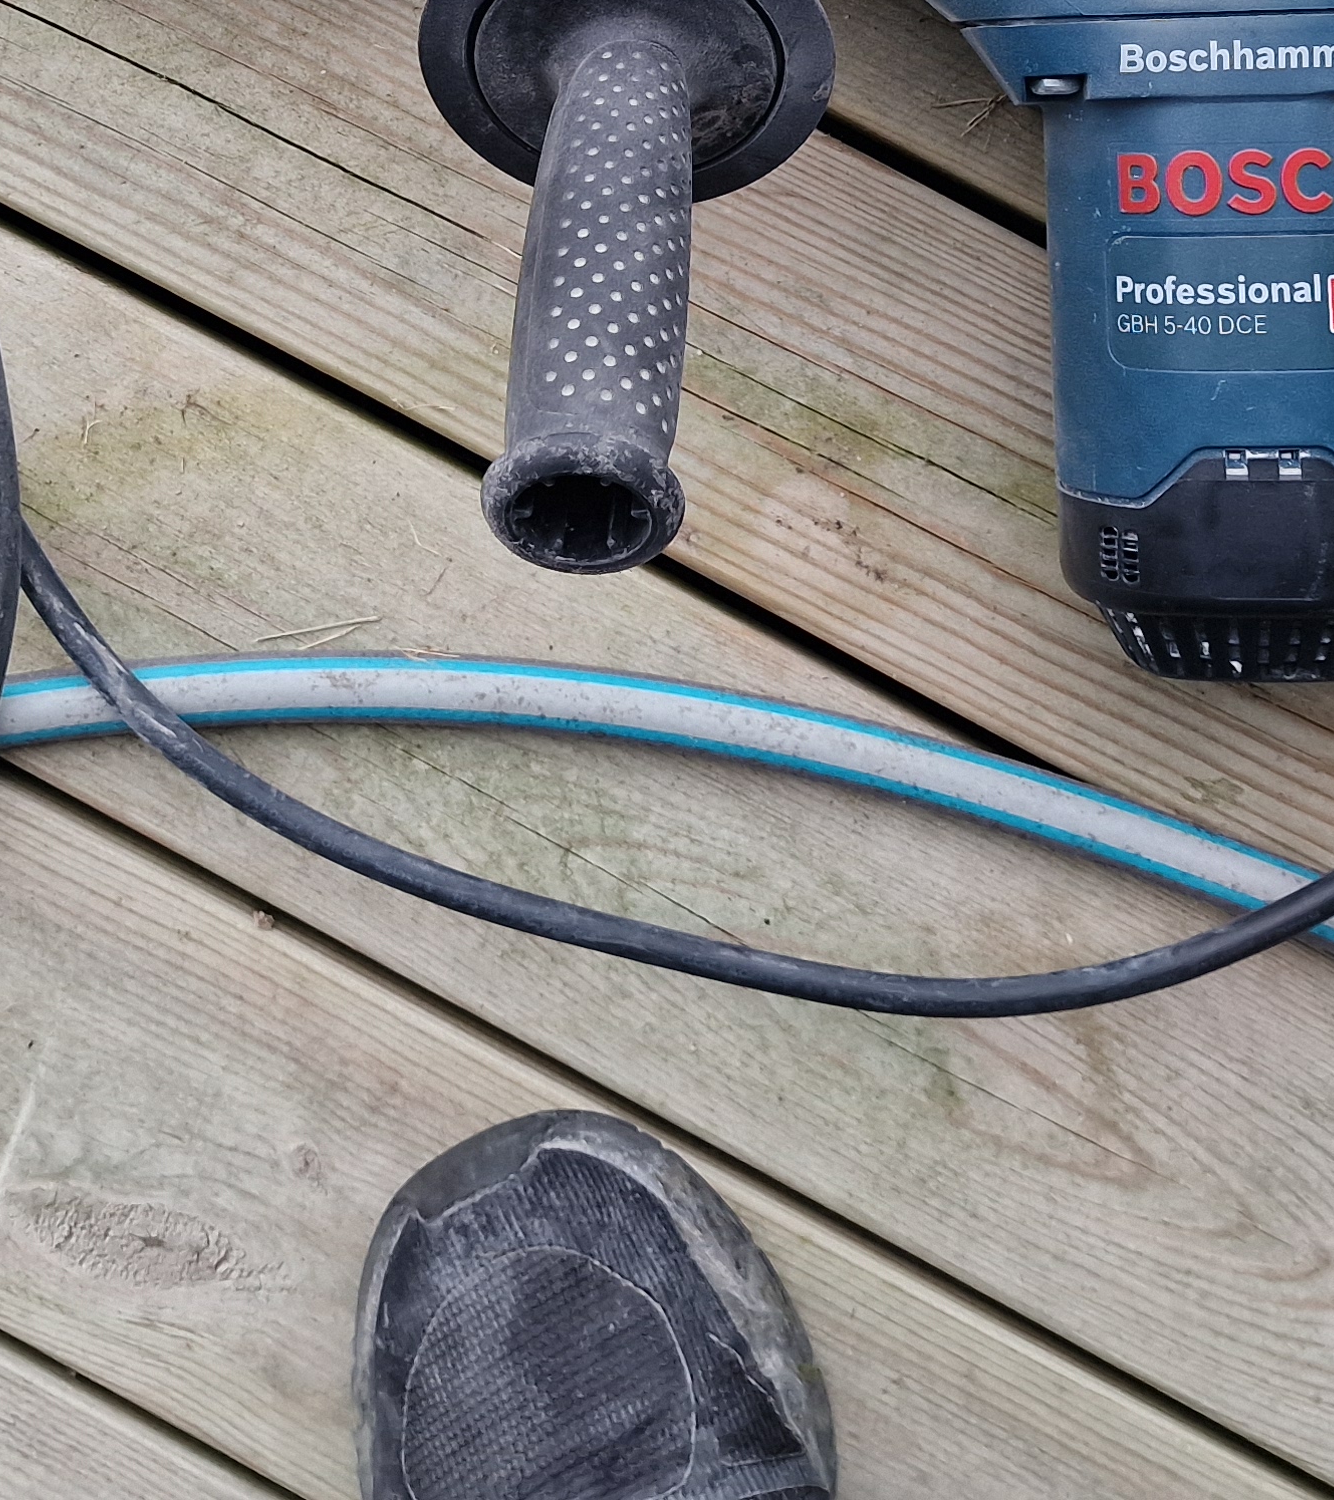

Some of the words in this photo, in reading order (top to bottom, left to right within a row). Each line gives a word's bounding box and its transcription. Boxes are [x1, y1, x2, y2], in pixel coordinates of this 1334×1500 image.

[1116, 274, 1321, 304] Professional
[1117, 314, 1158, 334] GBH
[1163, 315, 1212, 335] 5-40
[1218, 314, 1267, 334] DCE
